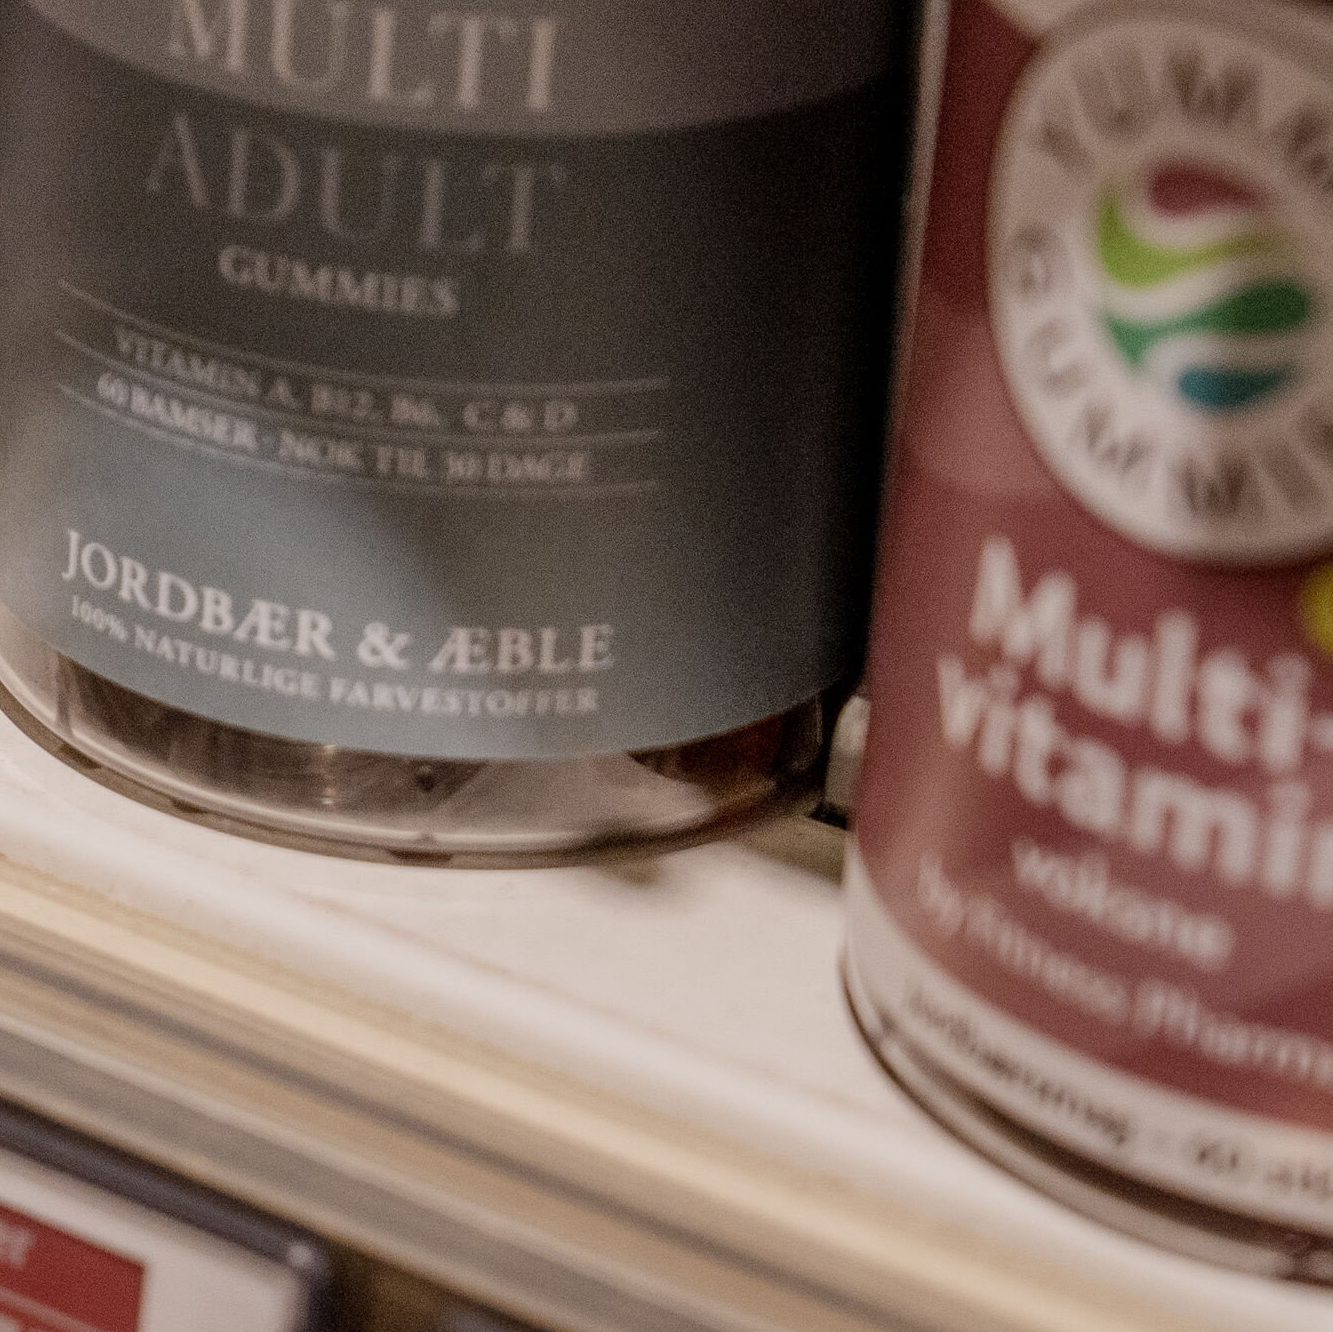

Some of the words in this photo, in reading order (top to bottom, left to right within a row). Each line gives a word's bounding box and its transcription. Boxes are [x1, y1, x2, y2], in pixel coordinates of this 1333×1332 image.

[143, 114, 568, 258] ADULT
[218, 244, 461, 320] GUMMIES
[61, 528, 336, 660] JORDBÆR
[357, 620, 411, 670] &
[429, 622, 616, 675] ÆBLE
[70, 594, 130, 642] 100%
[133, 623, 320, 702] NATURLIGE
